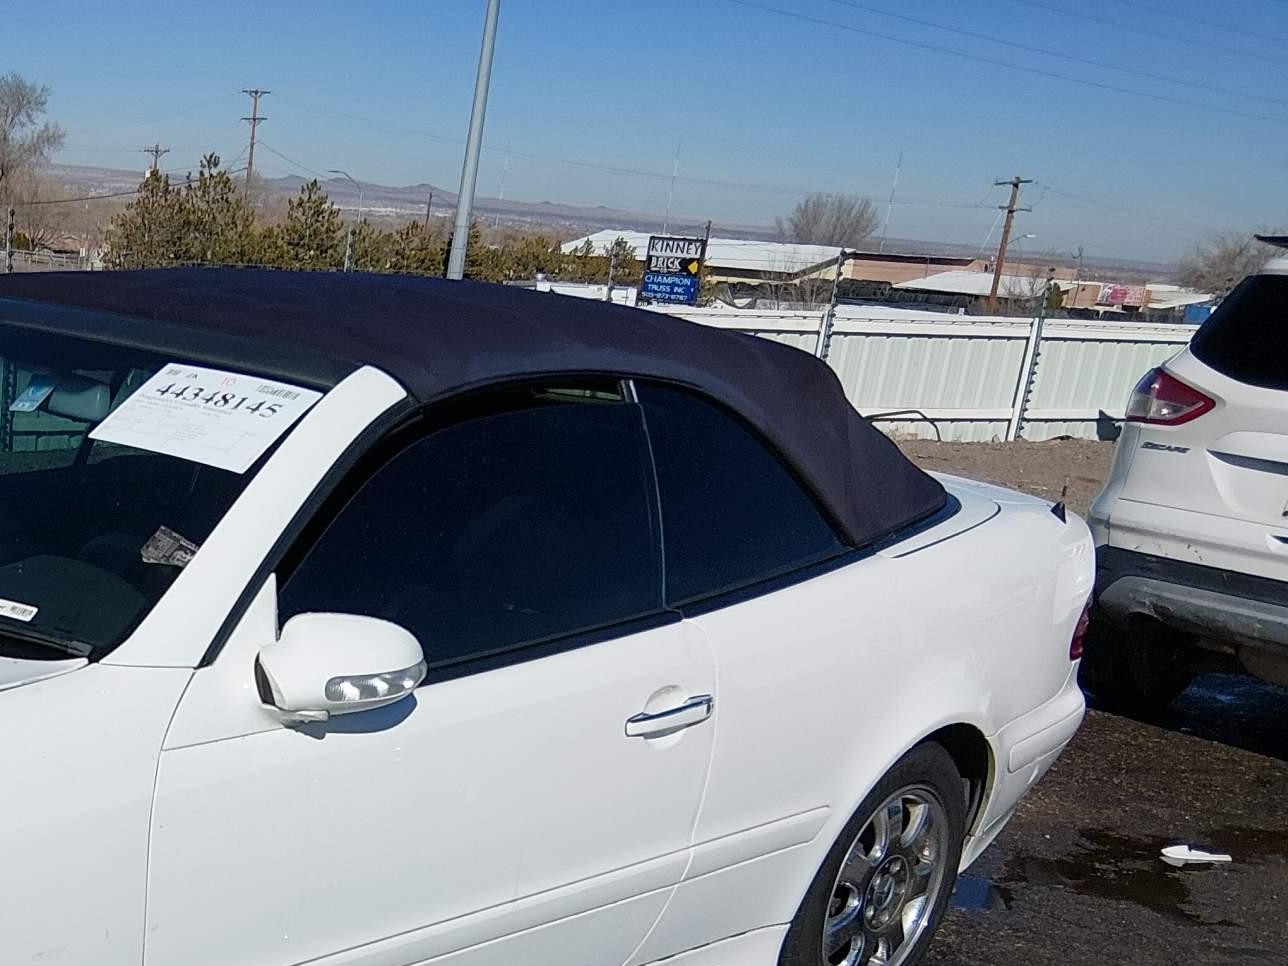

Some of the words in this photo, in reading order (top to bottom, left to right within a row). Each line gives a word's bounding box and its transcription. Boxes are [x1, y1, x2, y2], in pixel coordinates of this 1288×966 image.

[651, 239, 702, 255] KINNEY
[651, 256, 681, 269] BRICK
[645, 275, 691, 286] CHAMPION
[648, 284, 671, 292] TRUSS
[156, 383, 283, 418] 44348145
